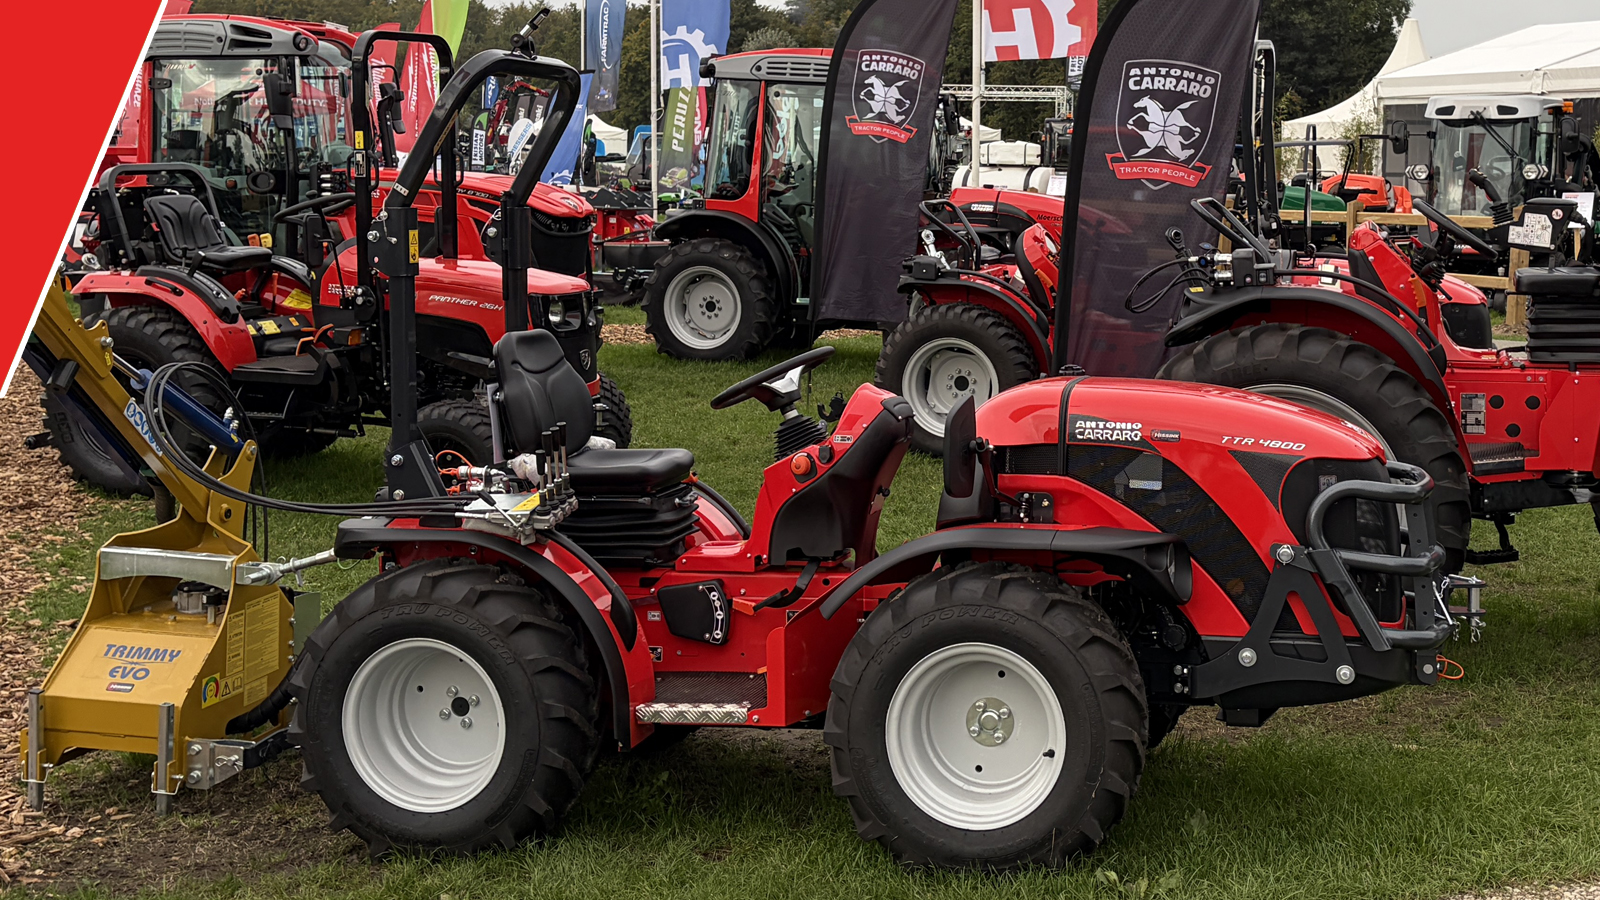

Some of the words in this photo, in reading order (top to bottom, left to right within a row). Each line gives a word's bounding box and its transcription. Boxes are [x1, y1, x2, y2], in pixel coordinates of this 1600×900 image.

[601, 7, 609, 62] FARMTRAC
[861, 61, 919, 80] CARRARO
[862, 55, 921, 70] ANTONIO
[1129, 67, 1216, 85] ANTONIO
[1128, 76, 1212, 98] CARRARO
[672, 86, 692, 152] PERUZ
[882, 128, 906, 139] PEOPLE
[1119, 166, 1160, 174] TRACTOR
[1161, 168, 1196, 181] PEOPLE
[428, 295, 478, 307] PANTHER
[479, 302, 504, 311] 26H
[1075, 420, 1142, 430] ANTONIO
[1075, 429, 1142, 441] CARRARO
[1221, 435, 1255, 446] TTR
[1259, 438, 1306, 451] 4800
[921, 605, 1021, 628] POWER
[380, 603, 430, 620] TRU
[435, 607, 517, 666] POWER
[103, 644, 182, 663] TRIMMY
[108, 665, 150, 681] EVO
